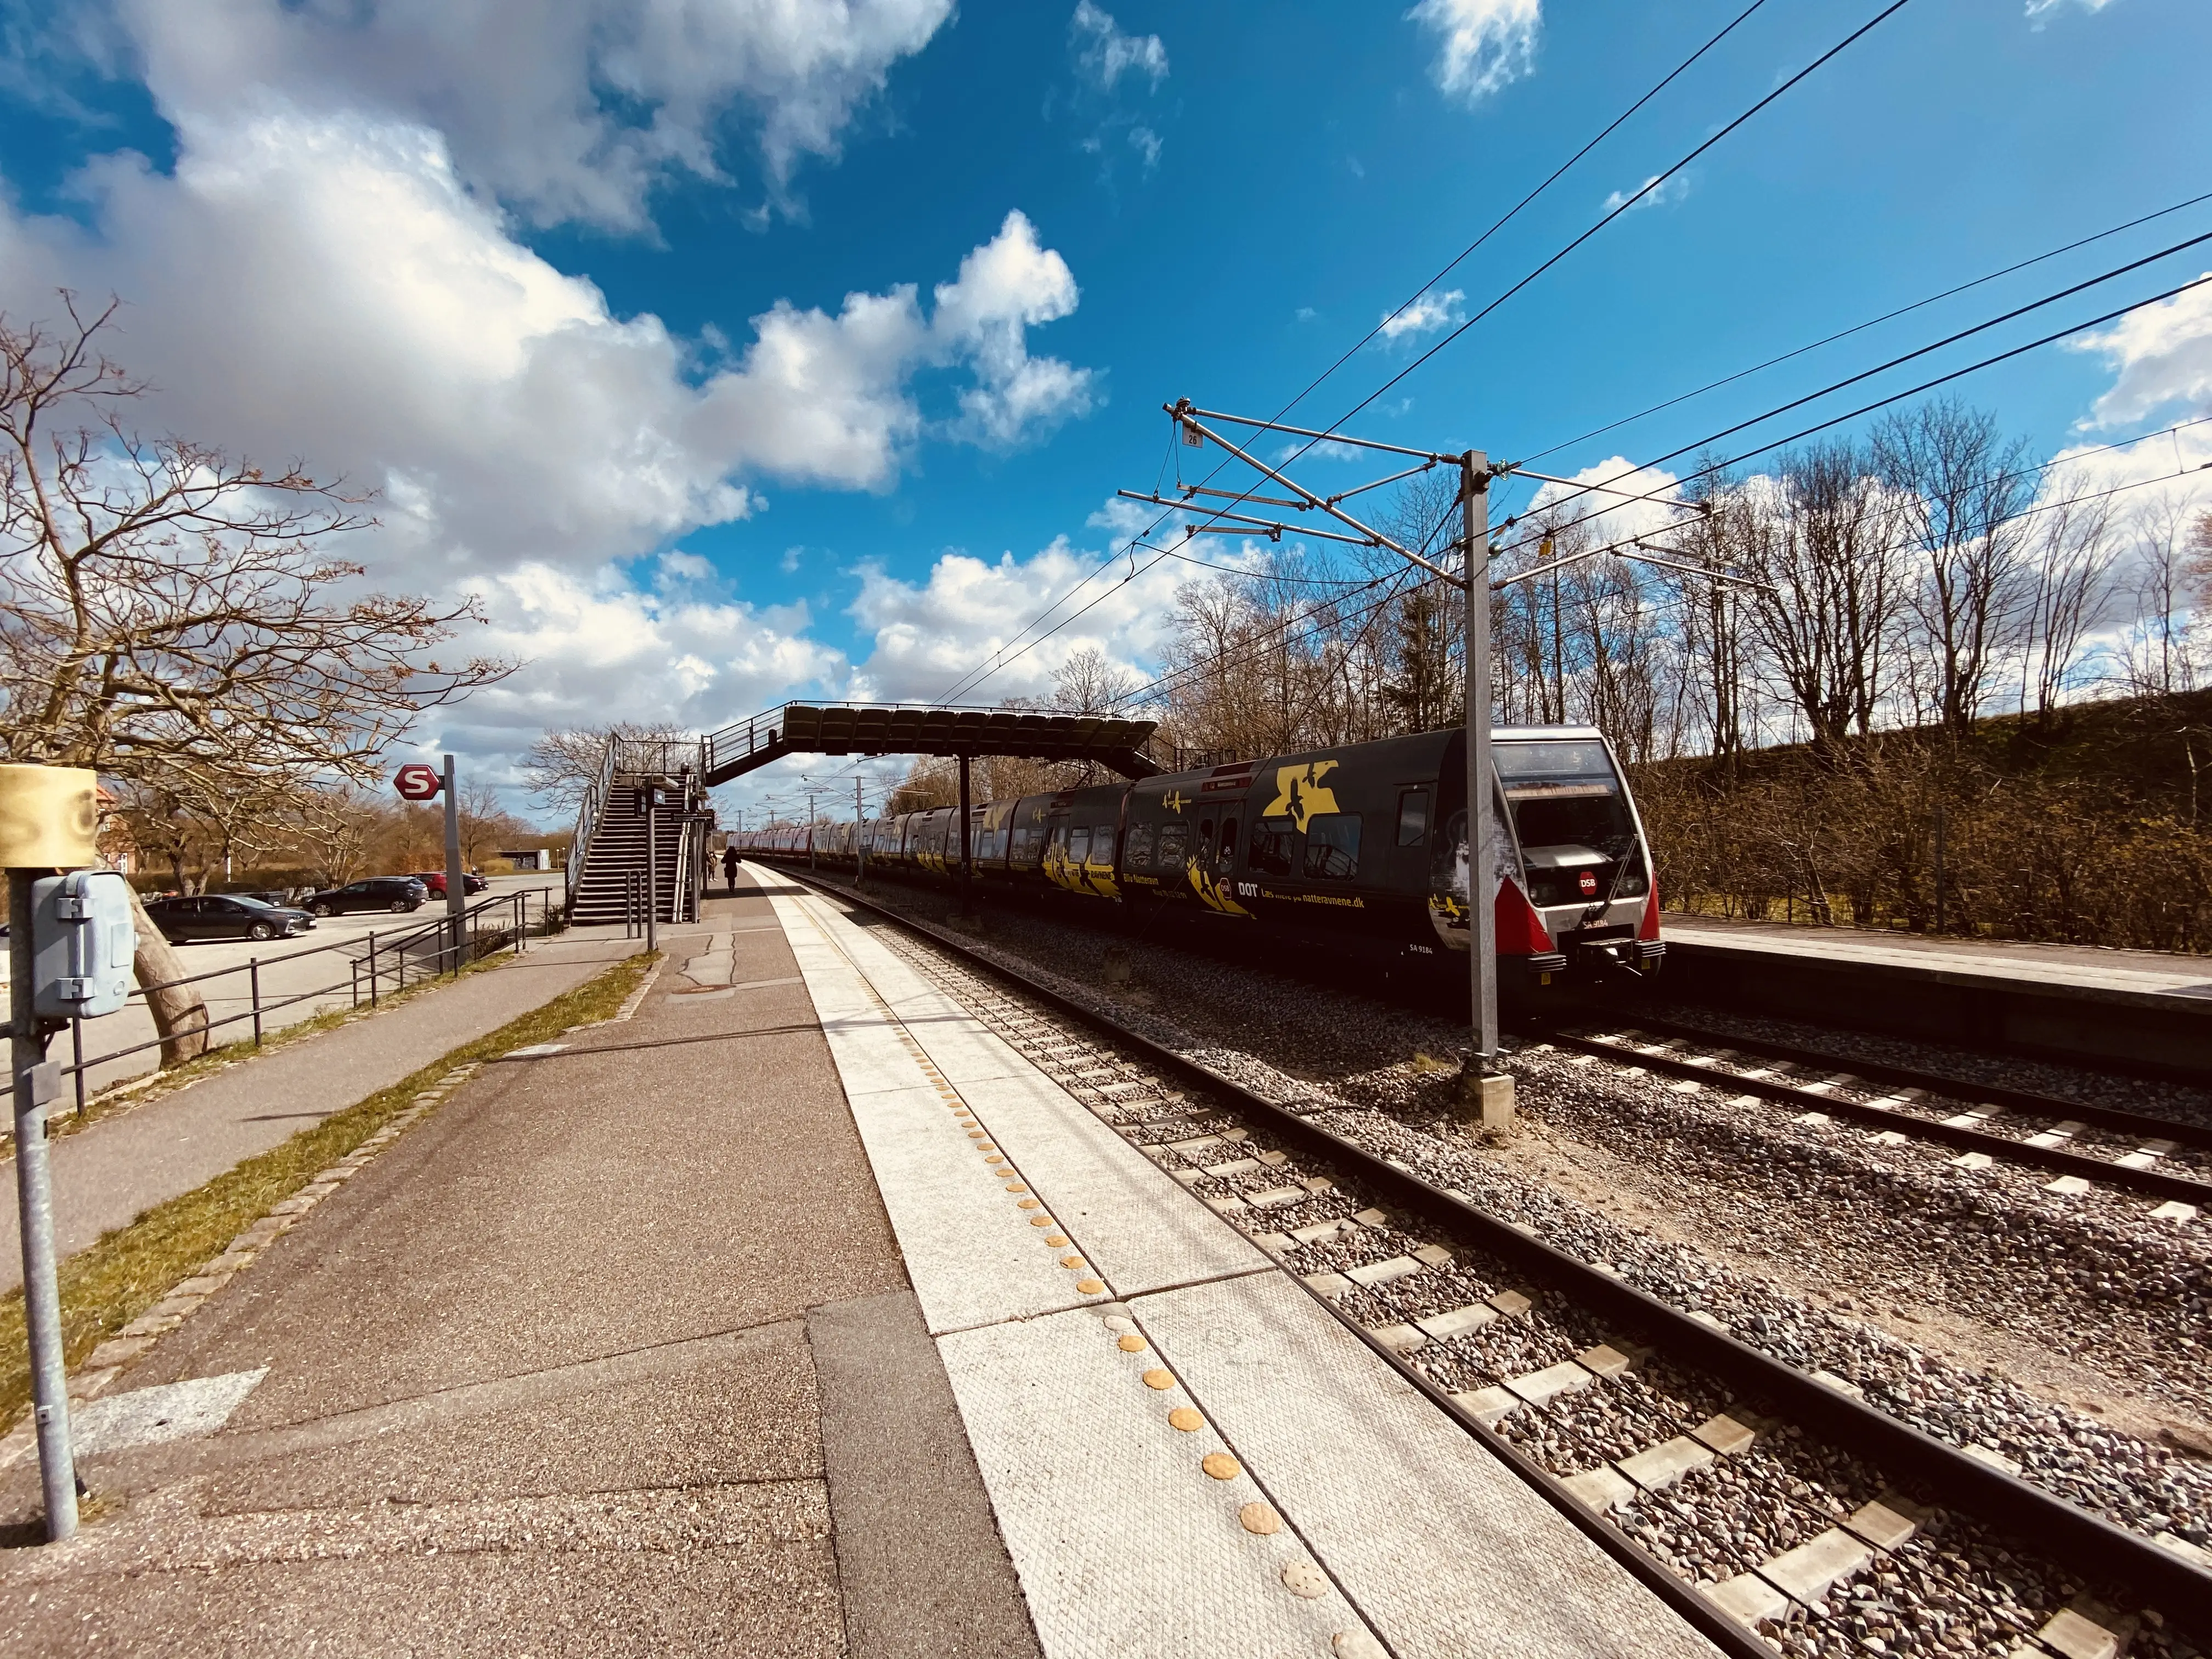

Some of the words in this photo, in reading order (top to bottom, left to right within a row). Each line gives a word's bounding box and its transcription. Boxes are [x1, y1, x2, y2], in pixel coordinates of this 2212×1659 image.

[1189, 435, 1197, 445] 26
[405, 770, 429, 793] S
[1581, 879, 1596, 888] DSB
[1238, 882, 1257, 897] DOT
[1302, 894, 1364, 908] natteravnene.dk
[1582, 921, 1592, 929] SA
[1593, 919, 1608, 928] 9184
[1409, 944, 1418, 952] SA
[1418, 945, 1433, 955] 9184
